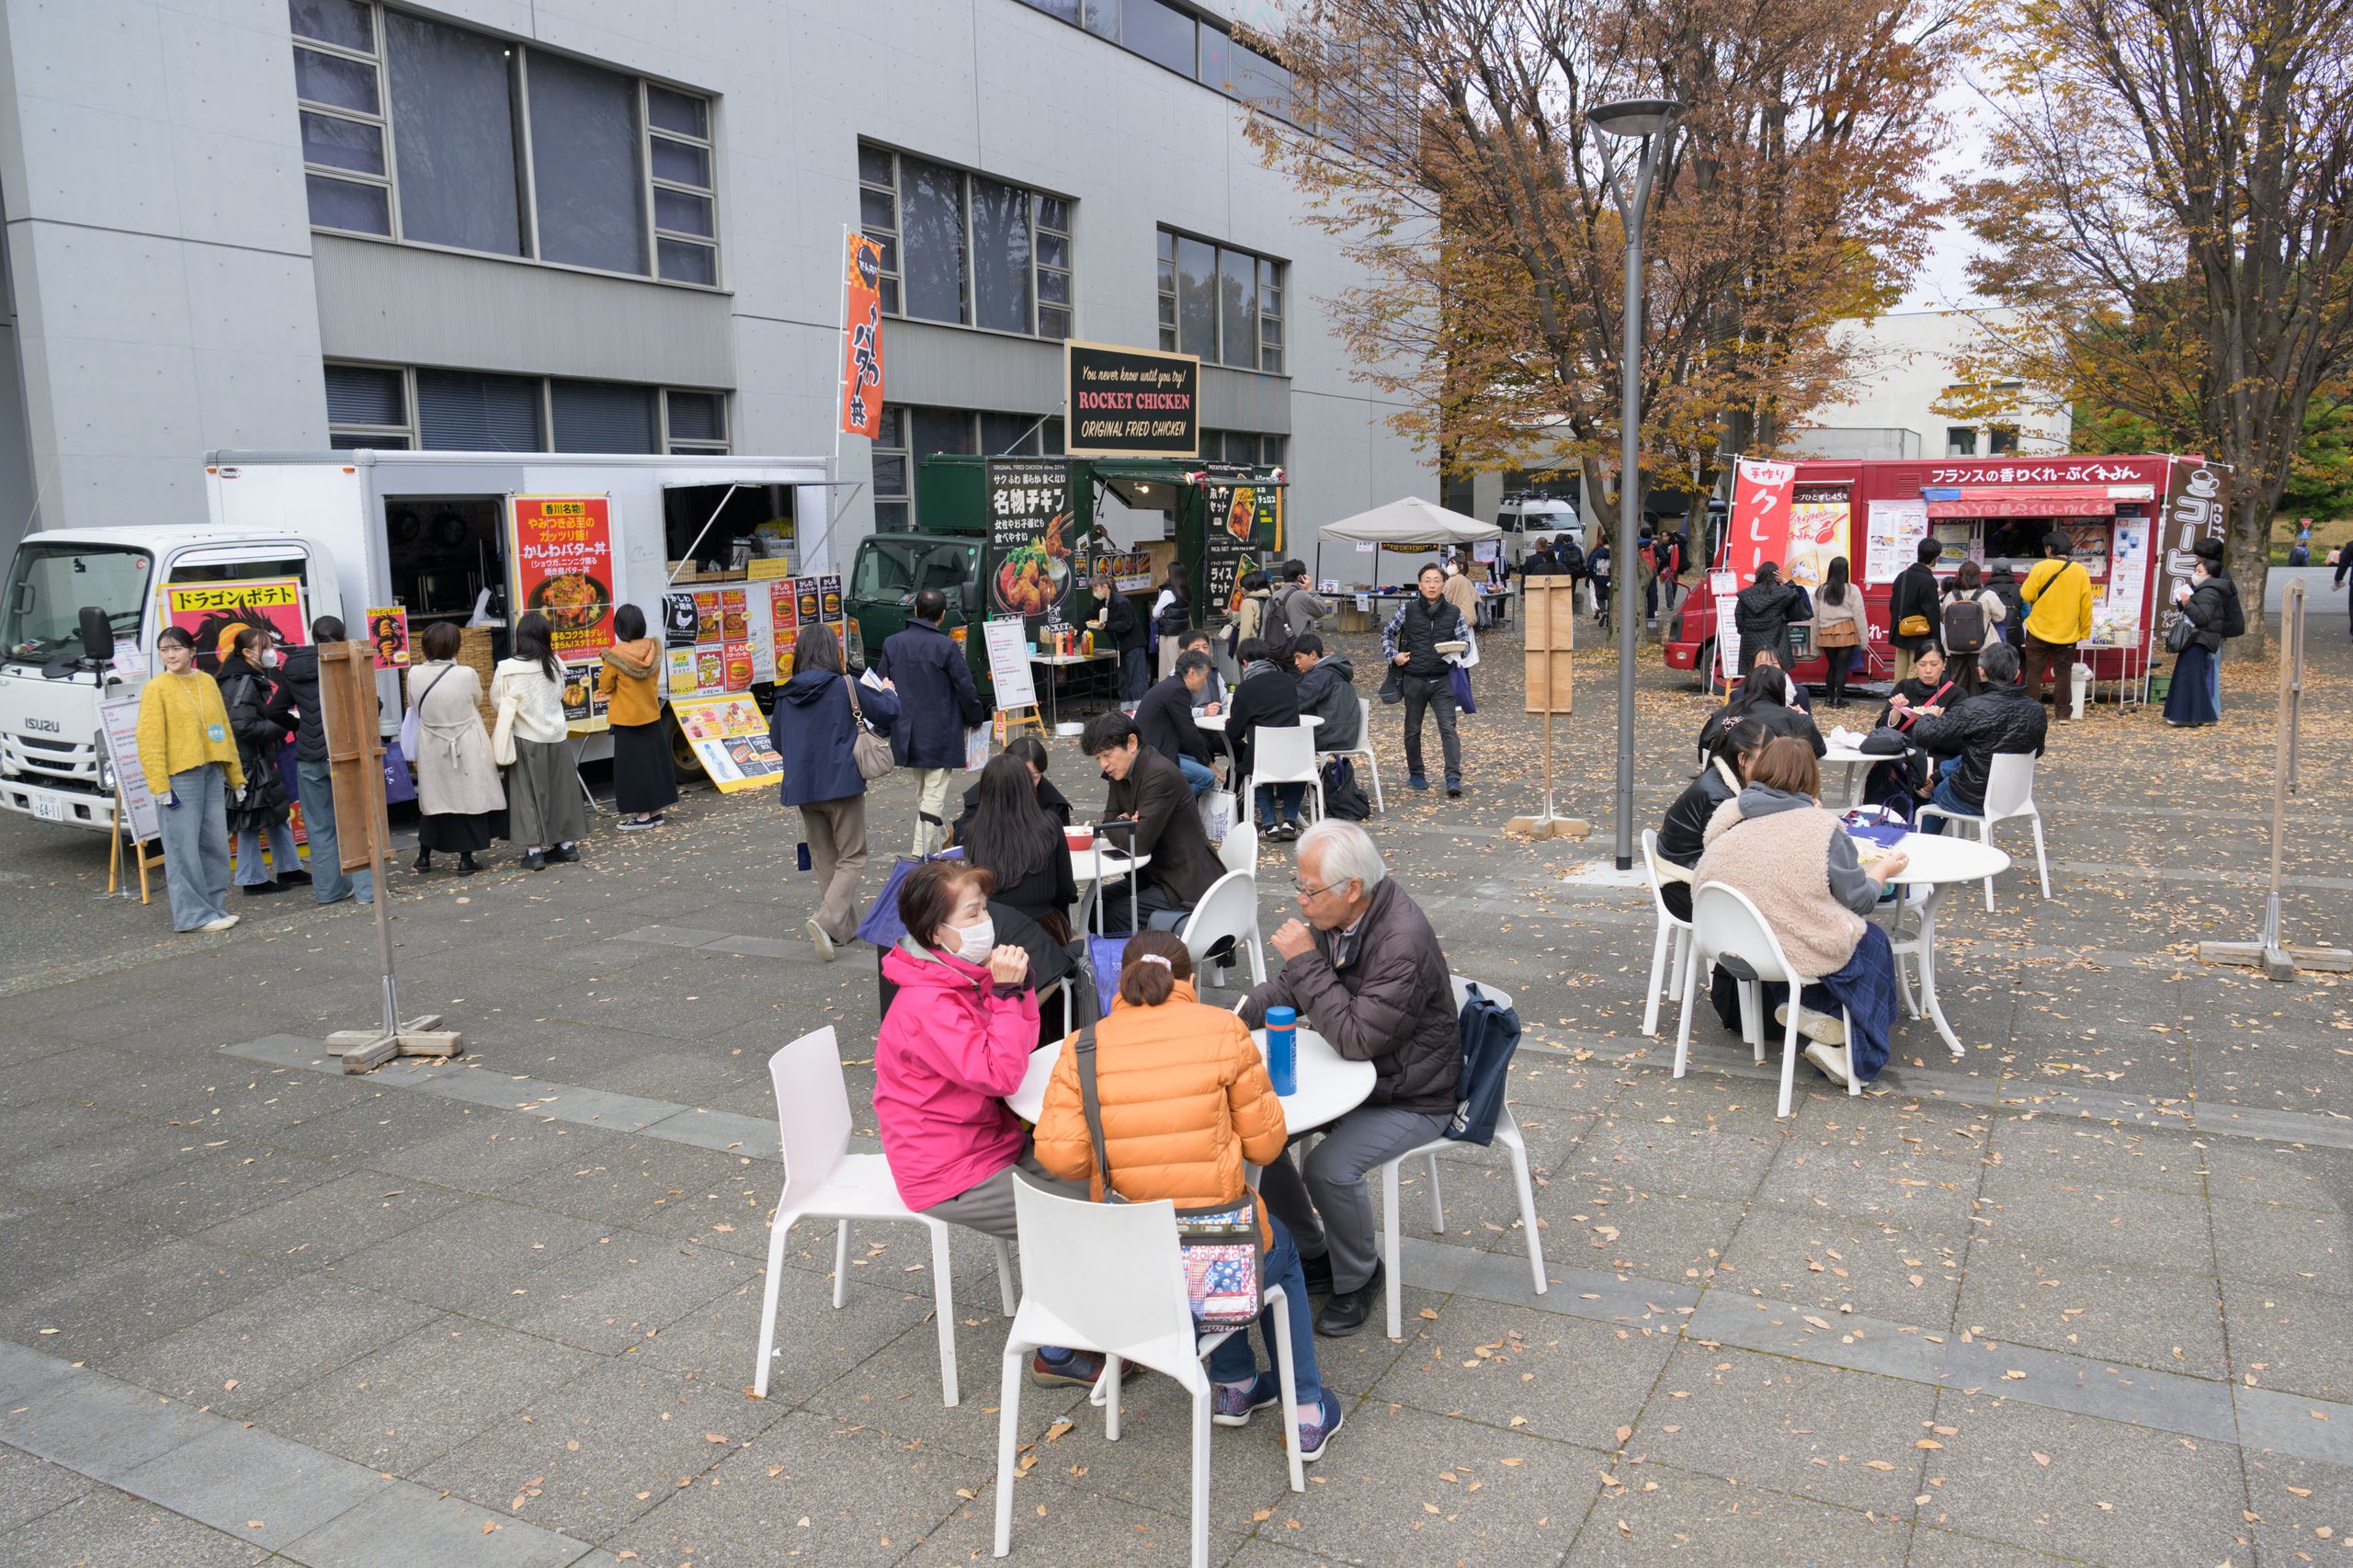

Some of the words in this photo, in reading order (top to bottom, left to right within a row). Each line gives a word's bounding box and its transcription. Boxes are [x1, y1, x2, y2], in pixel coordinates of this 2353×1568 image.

[1082, 366, 1097, 381] You
[1098, 372, 1119, 381] never
[1120, 366, 1139, 381] know
[1141, 368, 1158, 381] until
[1158, 373, 1171, 389] you
[1172, 369, 1187, 389] try!
[1079, 392, 1133, 409] ROCKET
[1136, 393, 1190, 410] CHICKEN
[1081, 420, 1123, 437] ORIGINAL
[1124, 421, 1150, 437] FRIED
[1152, 421, 1186, 437] CHICKEN
[994, 474, 1006, 484] サク
[1751, 468, 1784, 480] 手作り
[546, 503, 585, 515] 香川名物!
[994, 489, 1065, 515] 名物チキン
[528, 517, 596, 529] やみつき必至の
[995, 517, 1044, 530] 女性やお子様にも
[995, 532, 1029, 543] 食べやすい
[523, 541, 607, 559] かしわバター丼
[1211, 567, 1233, 581] ライス
[1210, 582, 1230, 594] セット
[178, 587, 291, 609] ドラゴンポテト
[25, 717, 60, 733] ISUZU
